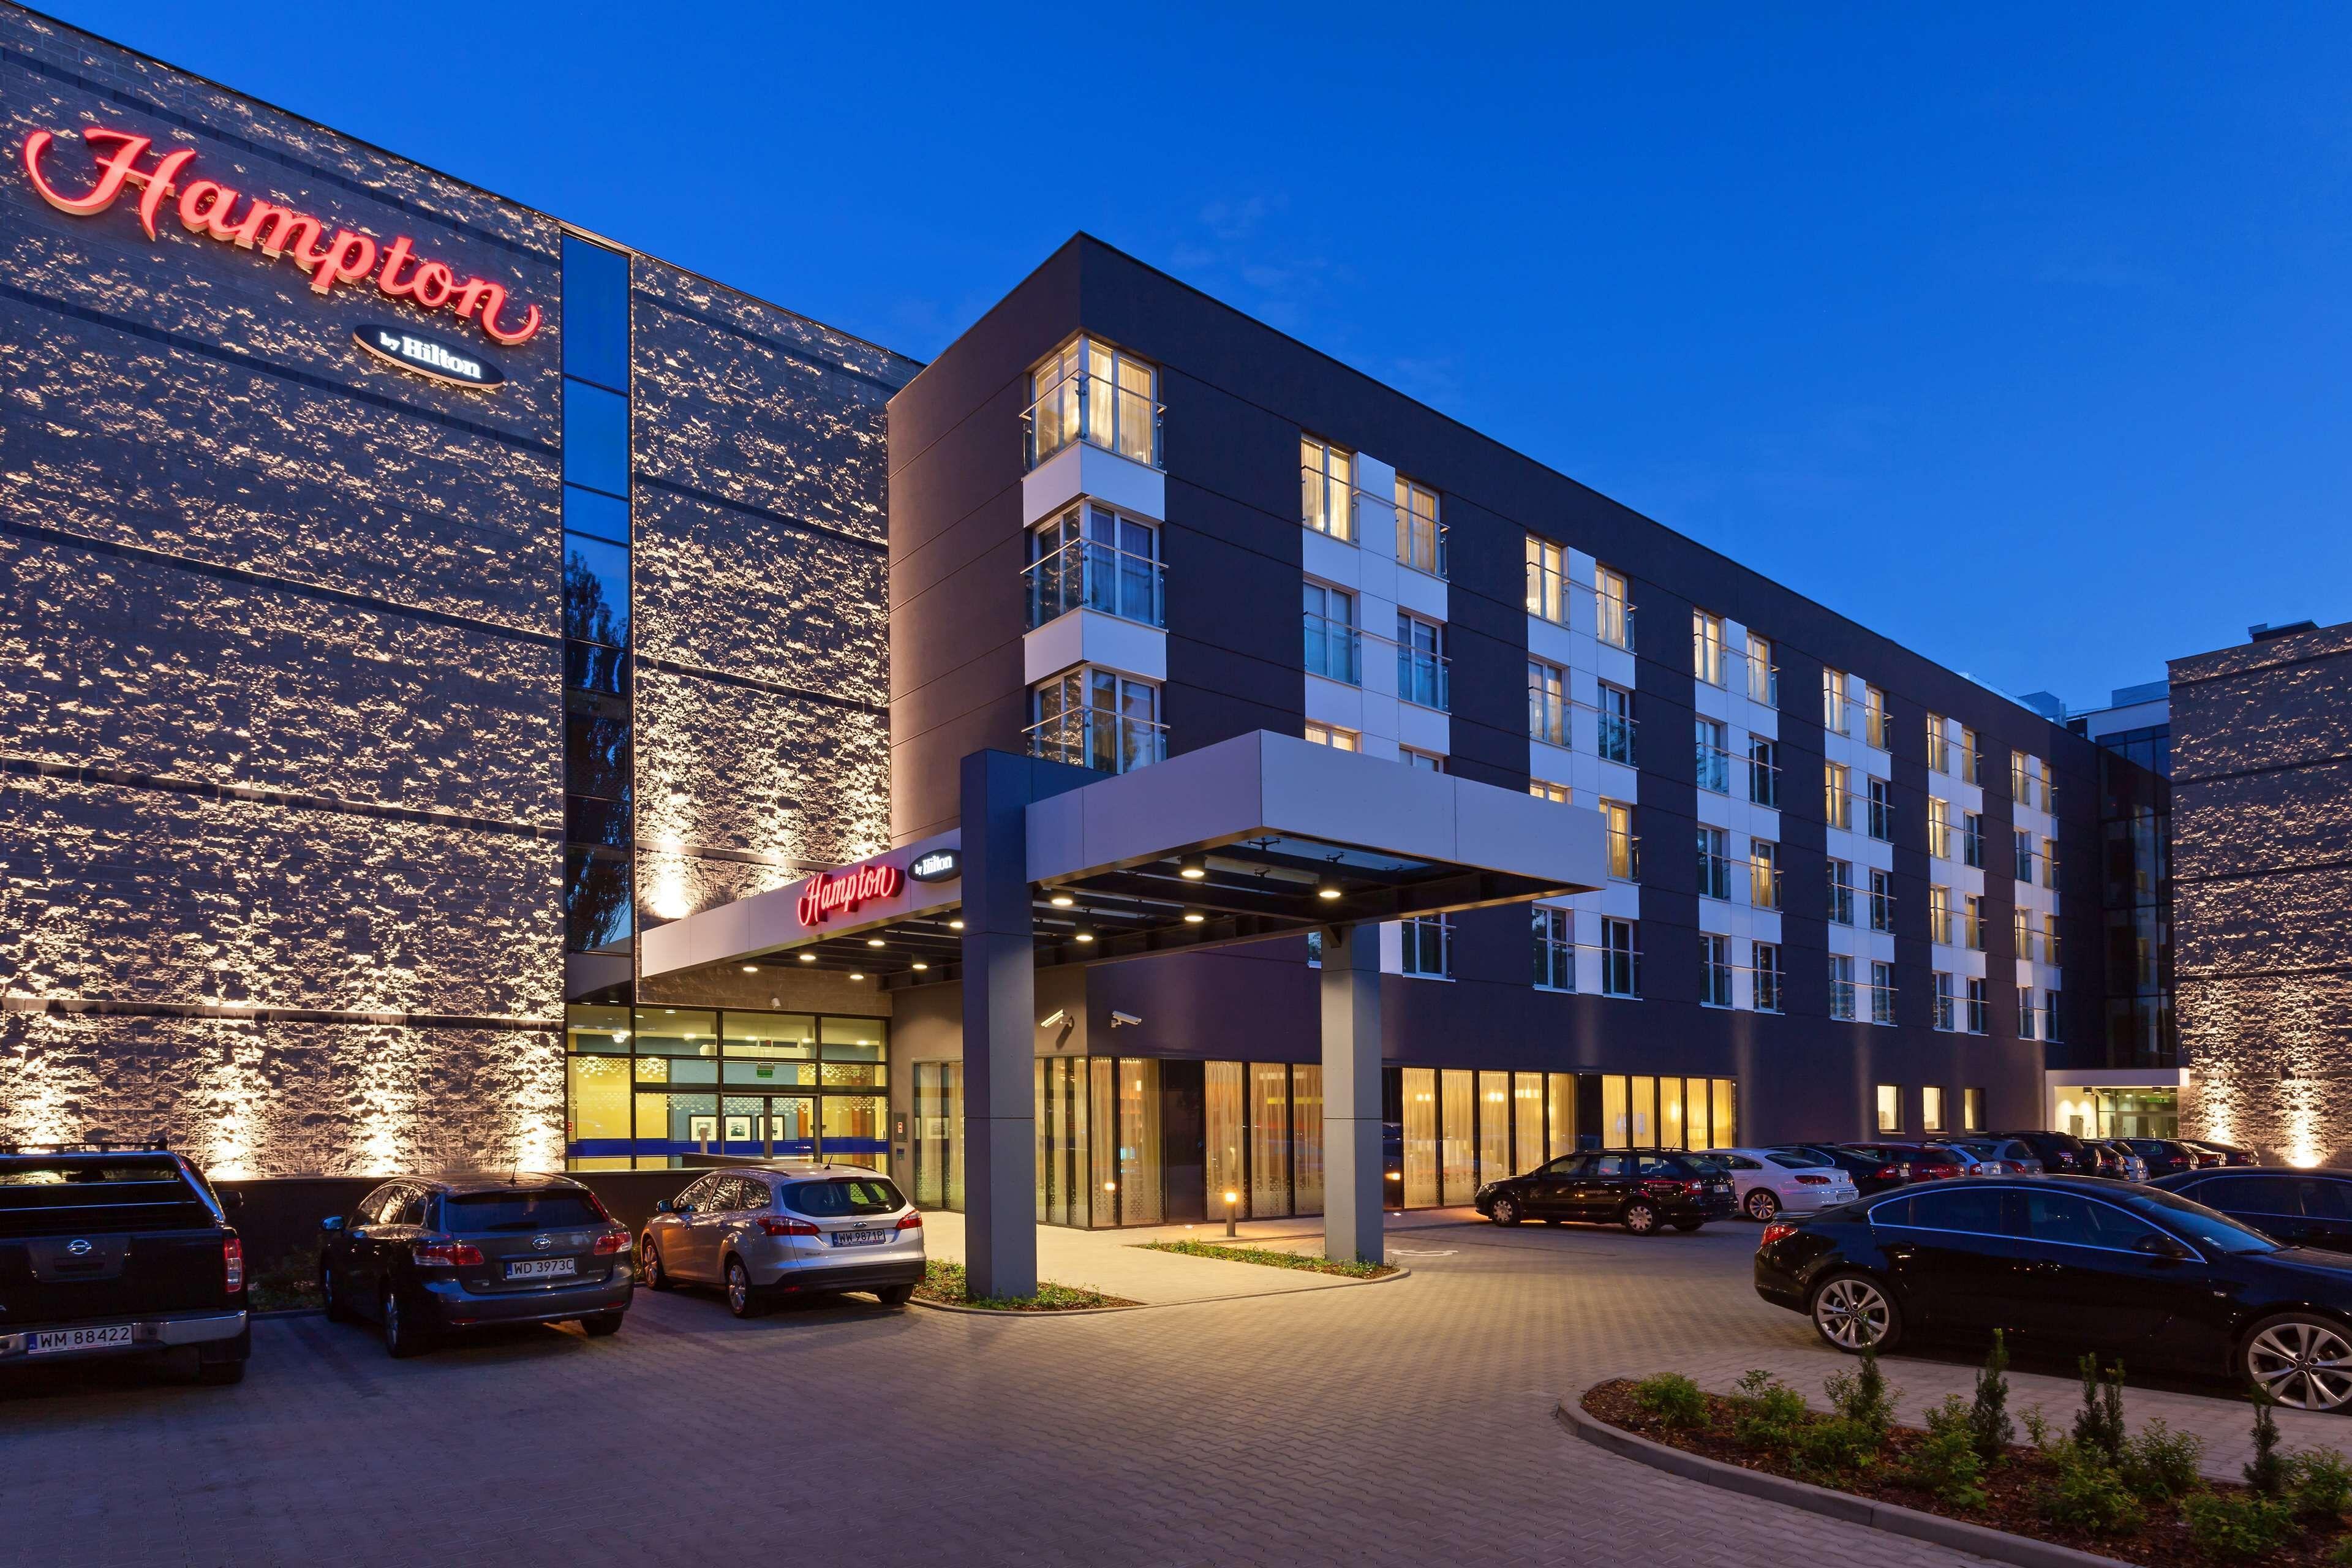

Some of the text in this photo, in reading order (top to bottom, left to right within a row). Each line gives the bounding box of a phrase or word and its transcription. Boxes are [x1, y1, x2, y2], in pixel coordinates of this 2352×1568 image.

[24, 128, 541, 345] Hampton
[380, 332, 481, 379] by Hilton
[915, 856, 952, 876] by Hilton
[797, 864, 895, 926] Hampton
[839, 1233, 853, 1242] WW
[514, 1262, 532, 1274] WD
[537, 1259, 573, 1272] 3973C
[40, 1327, 129, 1348] WM 88422
